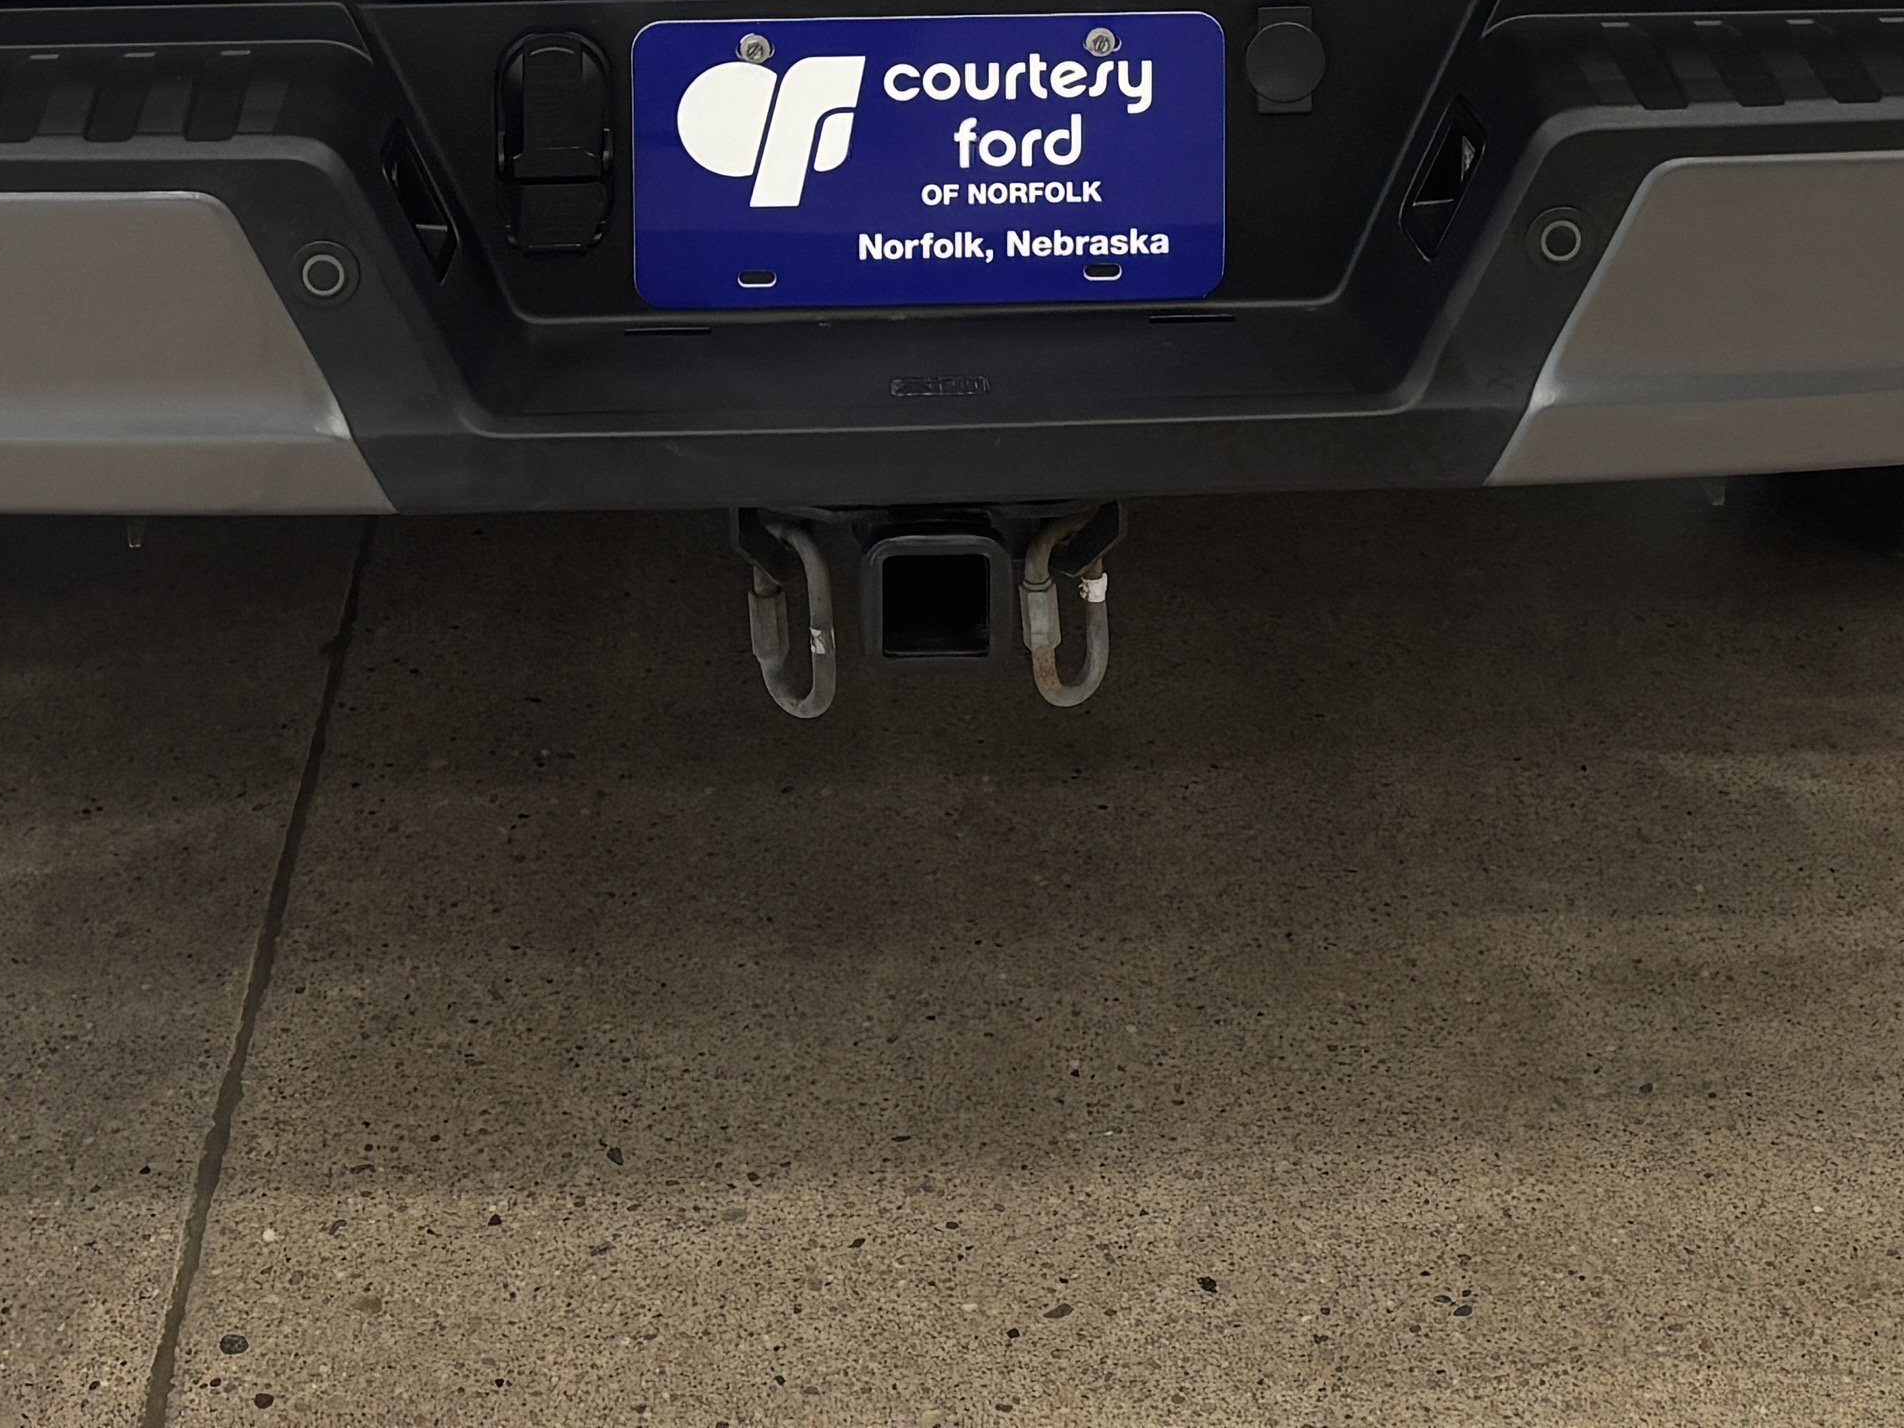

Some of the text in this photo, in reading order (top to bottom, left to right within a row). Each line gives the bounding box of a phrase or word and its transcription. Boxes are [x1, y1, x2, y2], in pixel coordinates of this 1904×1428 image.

[883, 52, 1153, 114] courtesy
[953, 113, 1083, 168] ford
[920, 179, 1103, 206] OF NORFOLK
[858, 227, 1170, 264] Norfolk, Nebraska
